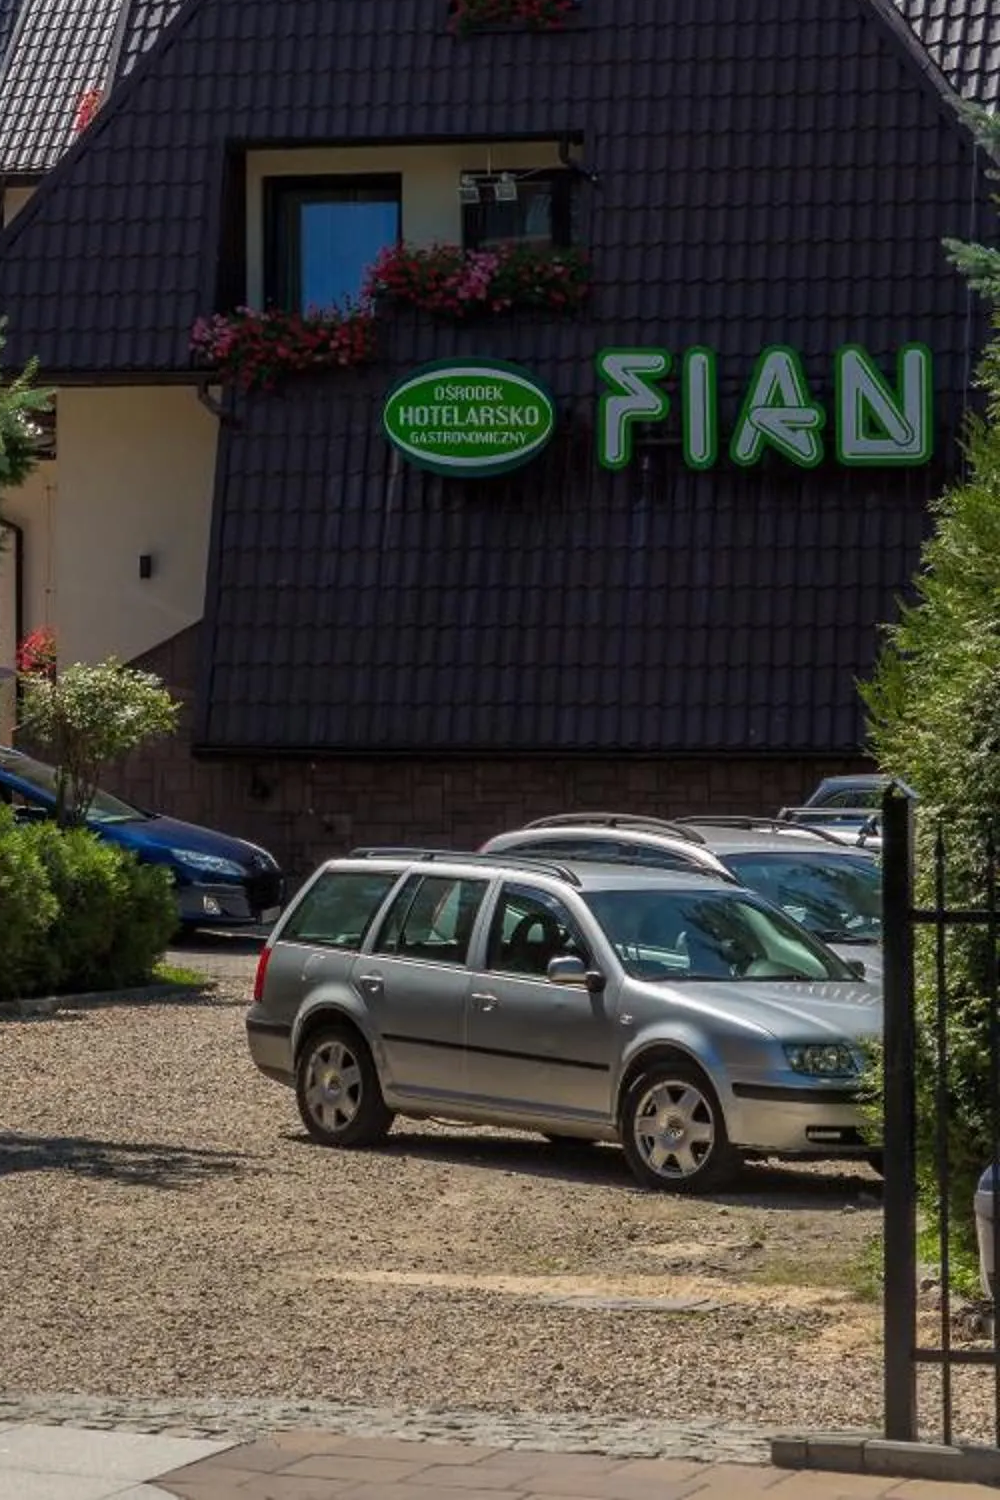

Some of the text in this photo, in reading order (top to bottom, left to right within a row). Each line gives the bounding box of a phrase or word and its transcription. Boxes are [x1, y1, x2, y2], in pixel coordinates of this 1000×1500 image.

[399, 405, 540, 426] HOTELARSKO
[598, 344, 932, 468] FIAN
[410, 431, 528, 445] GASTRONOMICZNY
